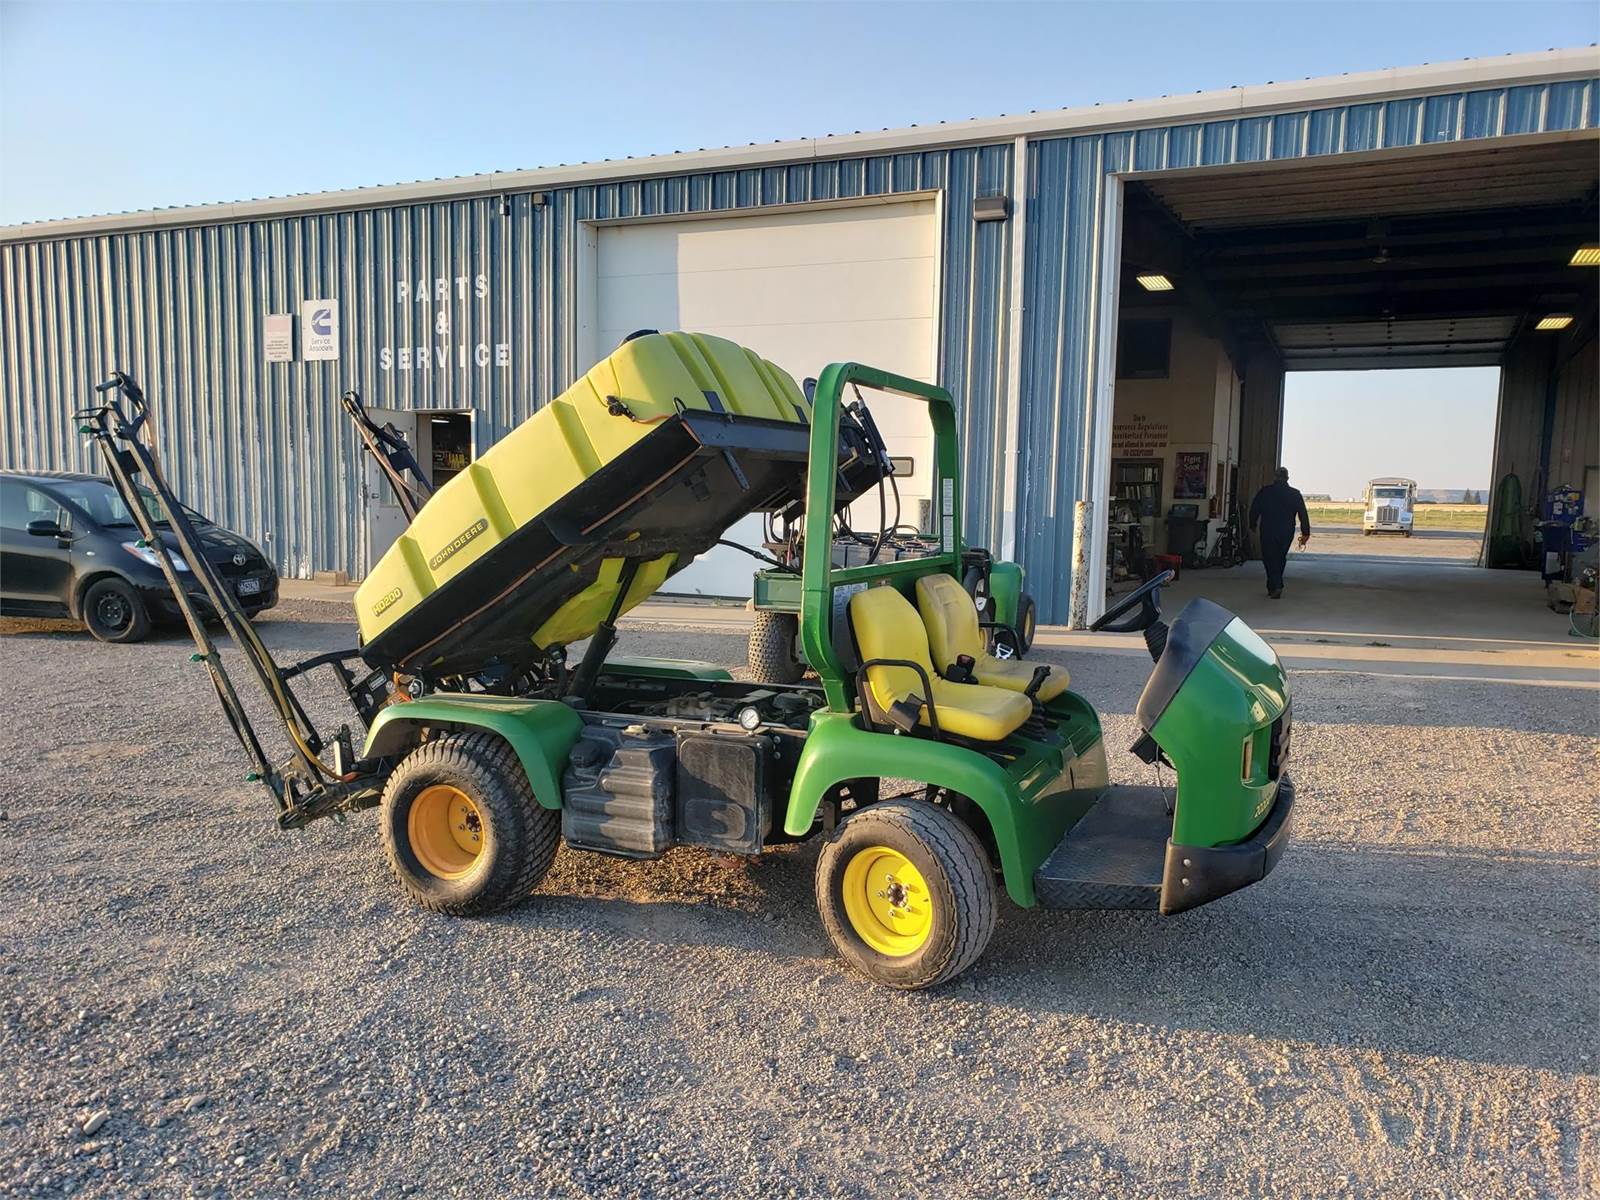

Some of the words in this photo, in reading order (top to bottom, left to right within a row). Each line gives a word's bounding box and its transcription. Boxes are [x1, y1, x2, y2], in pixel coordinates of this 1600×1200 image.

[397, 274, 489, 303] PARTS
[435, 311, 450, 335] &
[311, 337, 331, 345] Service
[380, 343, 511, 370] SERVICE
[431, 545, 455, 568] JOHN
[453, 521, 484, 549] DEERE
[372, 587, 403, 616] HD200
